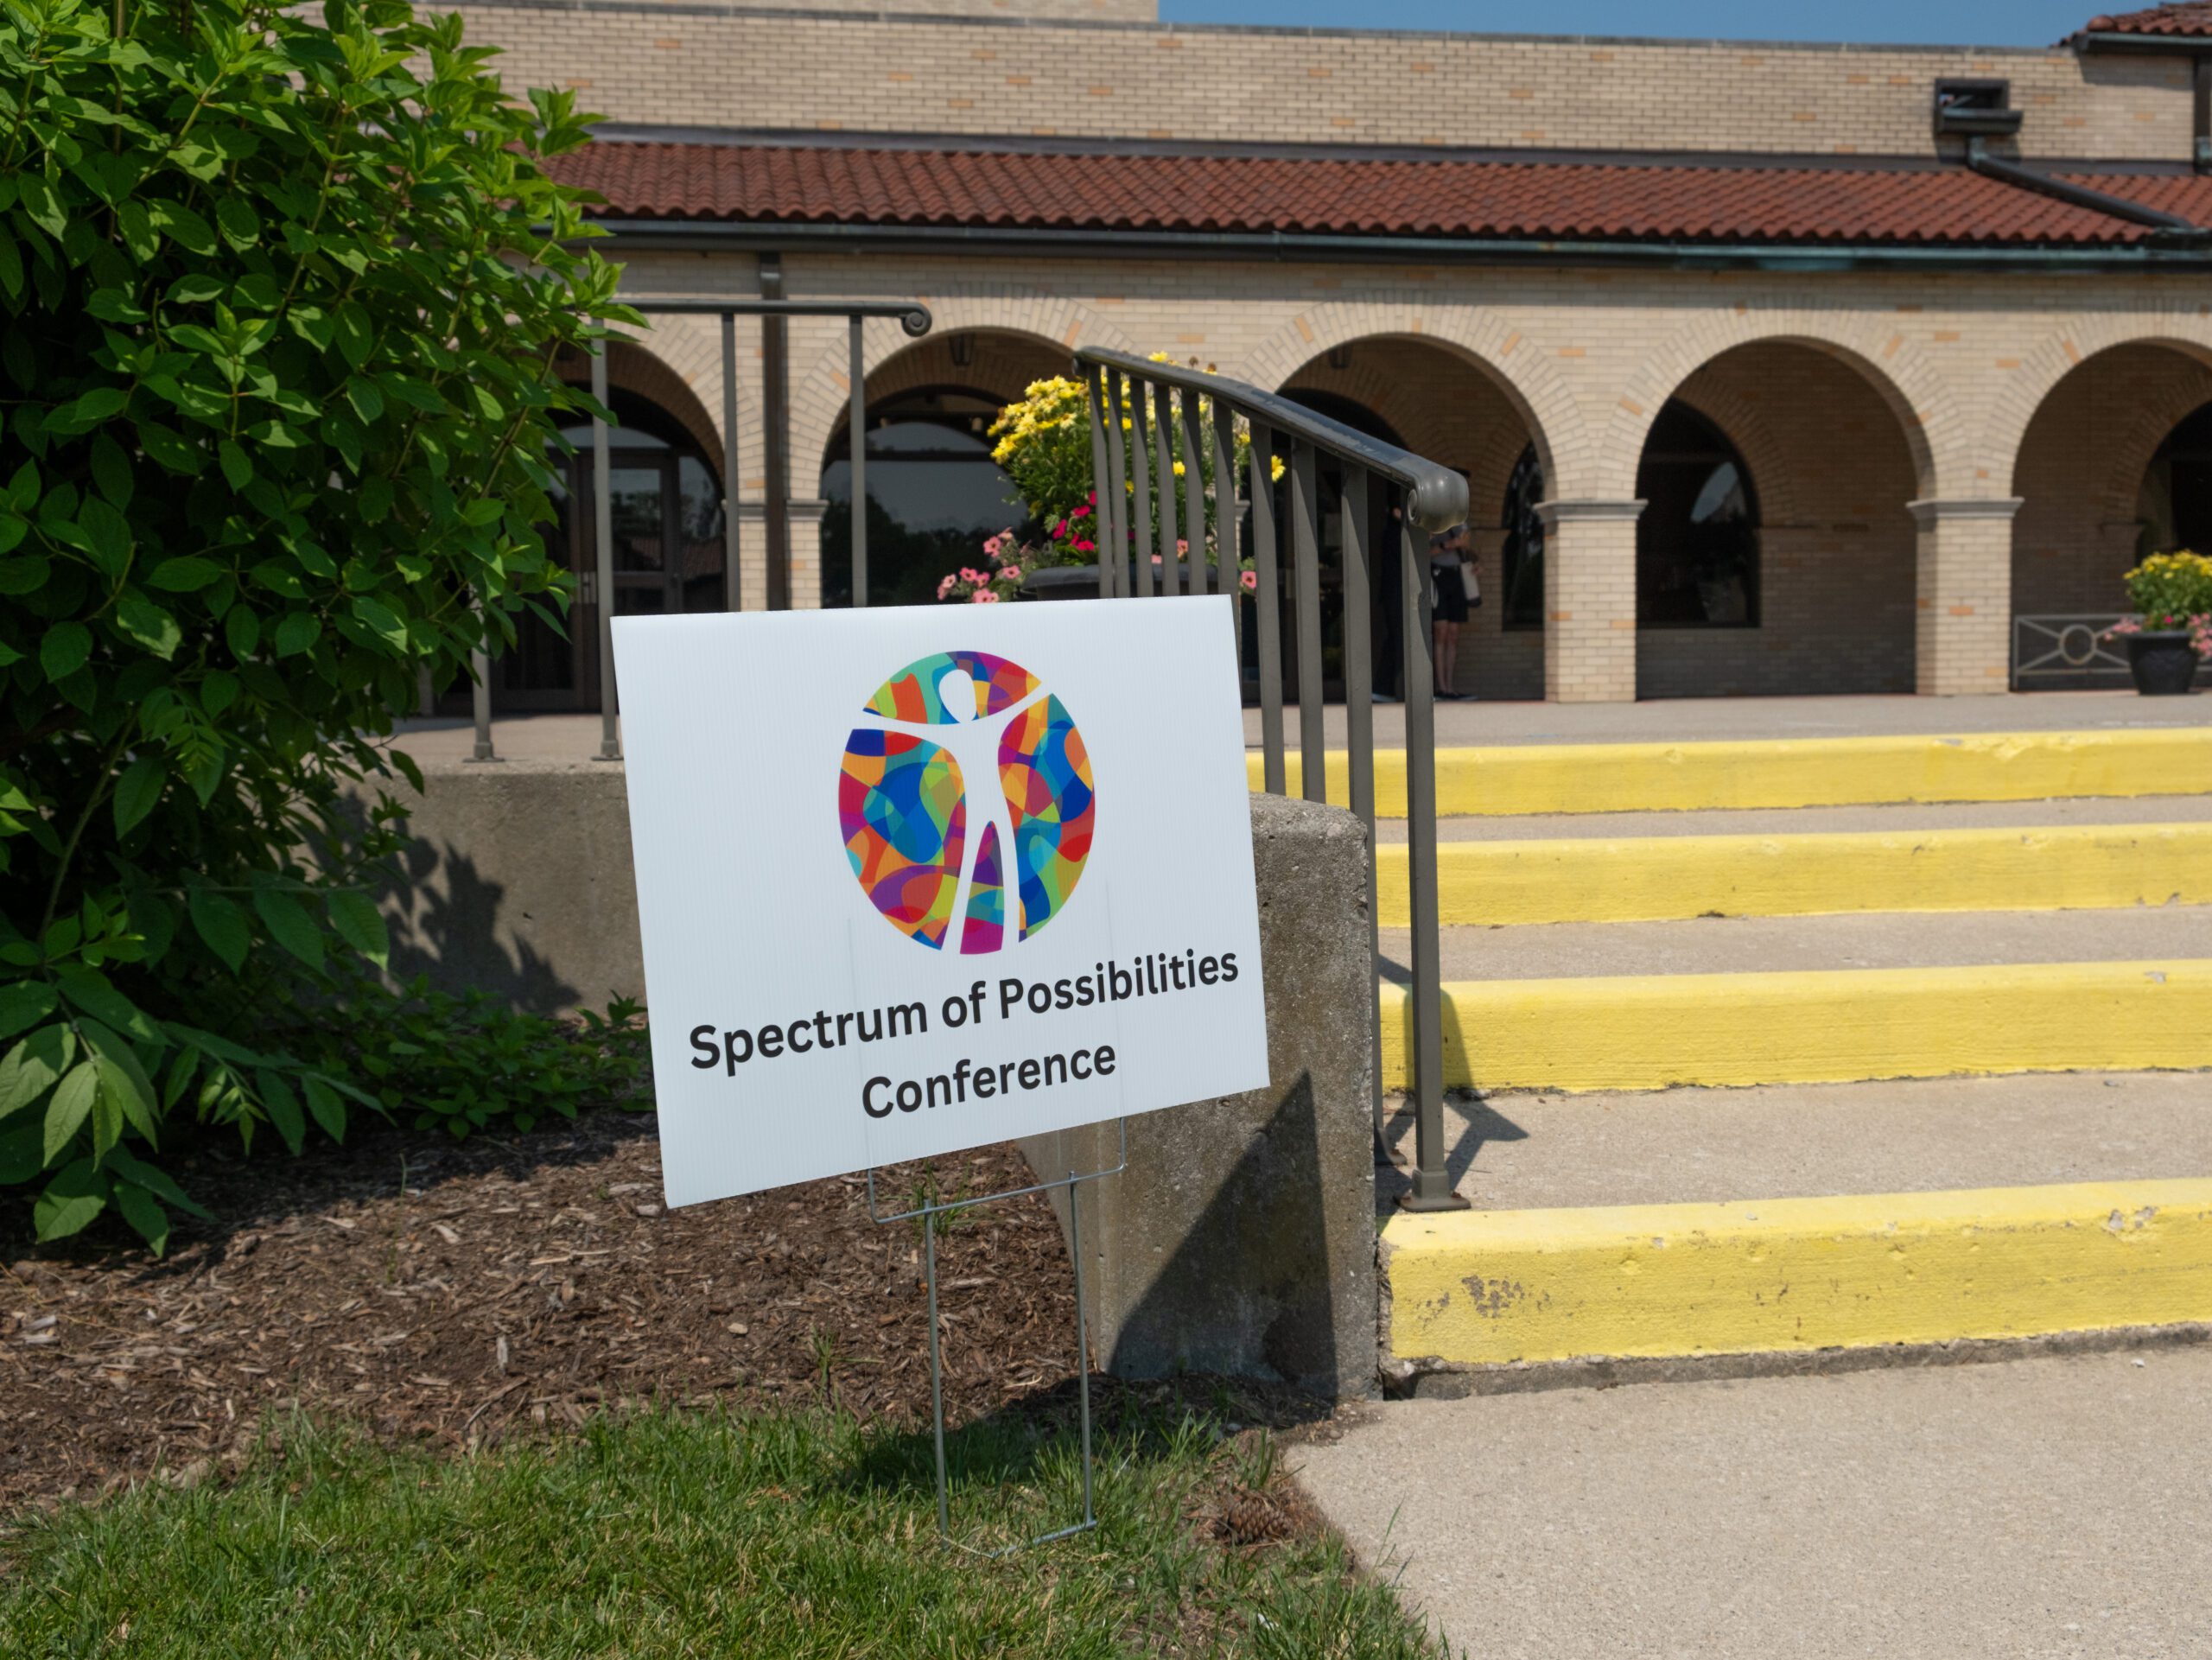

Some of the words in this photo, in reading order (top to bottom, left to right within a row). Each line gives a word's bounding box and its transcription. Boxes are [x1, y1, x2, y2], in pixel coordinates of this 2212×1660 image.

[690, 1001, 929, 1078] Spectrum
[941, 980, 987, 1028] of
[999, 948, 1239, 1020] Possibilities
[861, 1045, 1116, 1119] Conference
